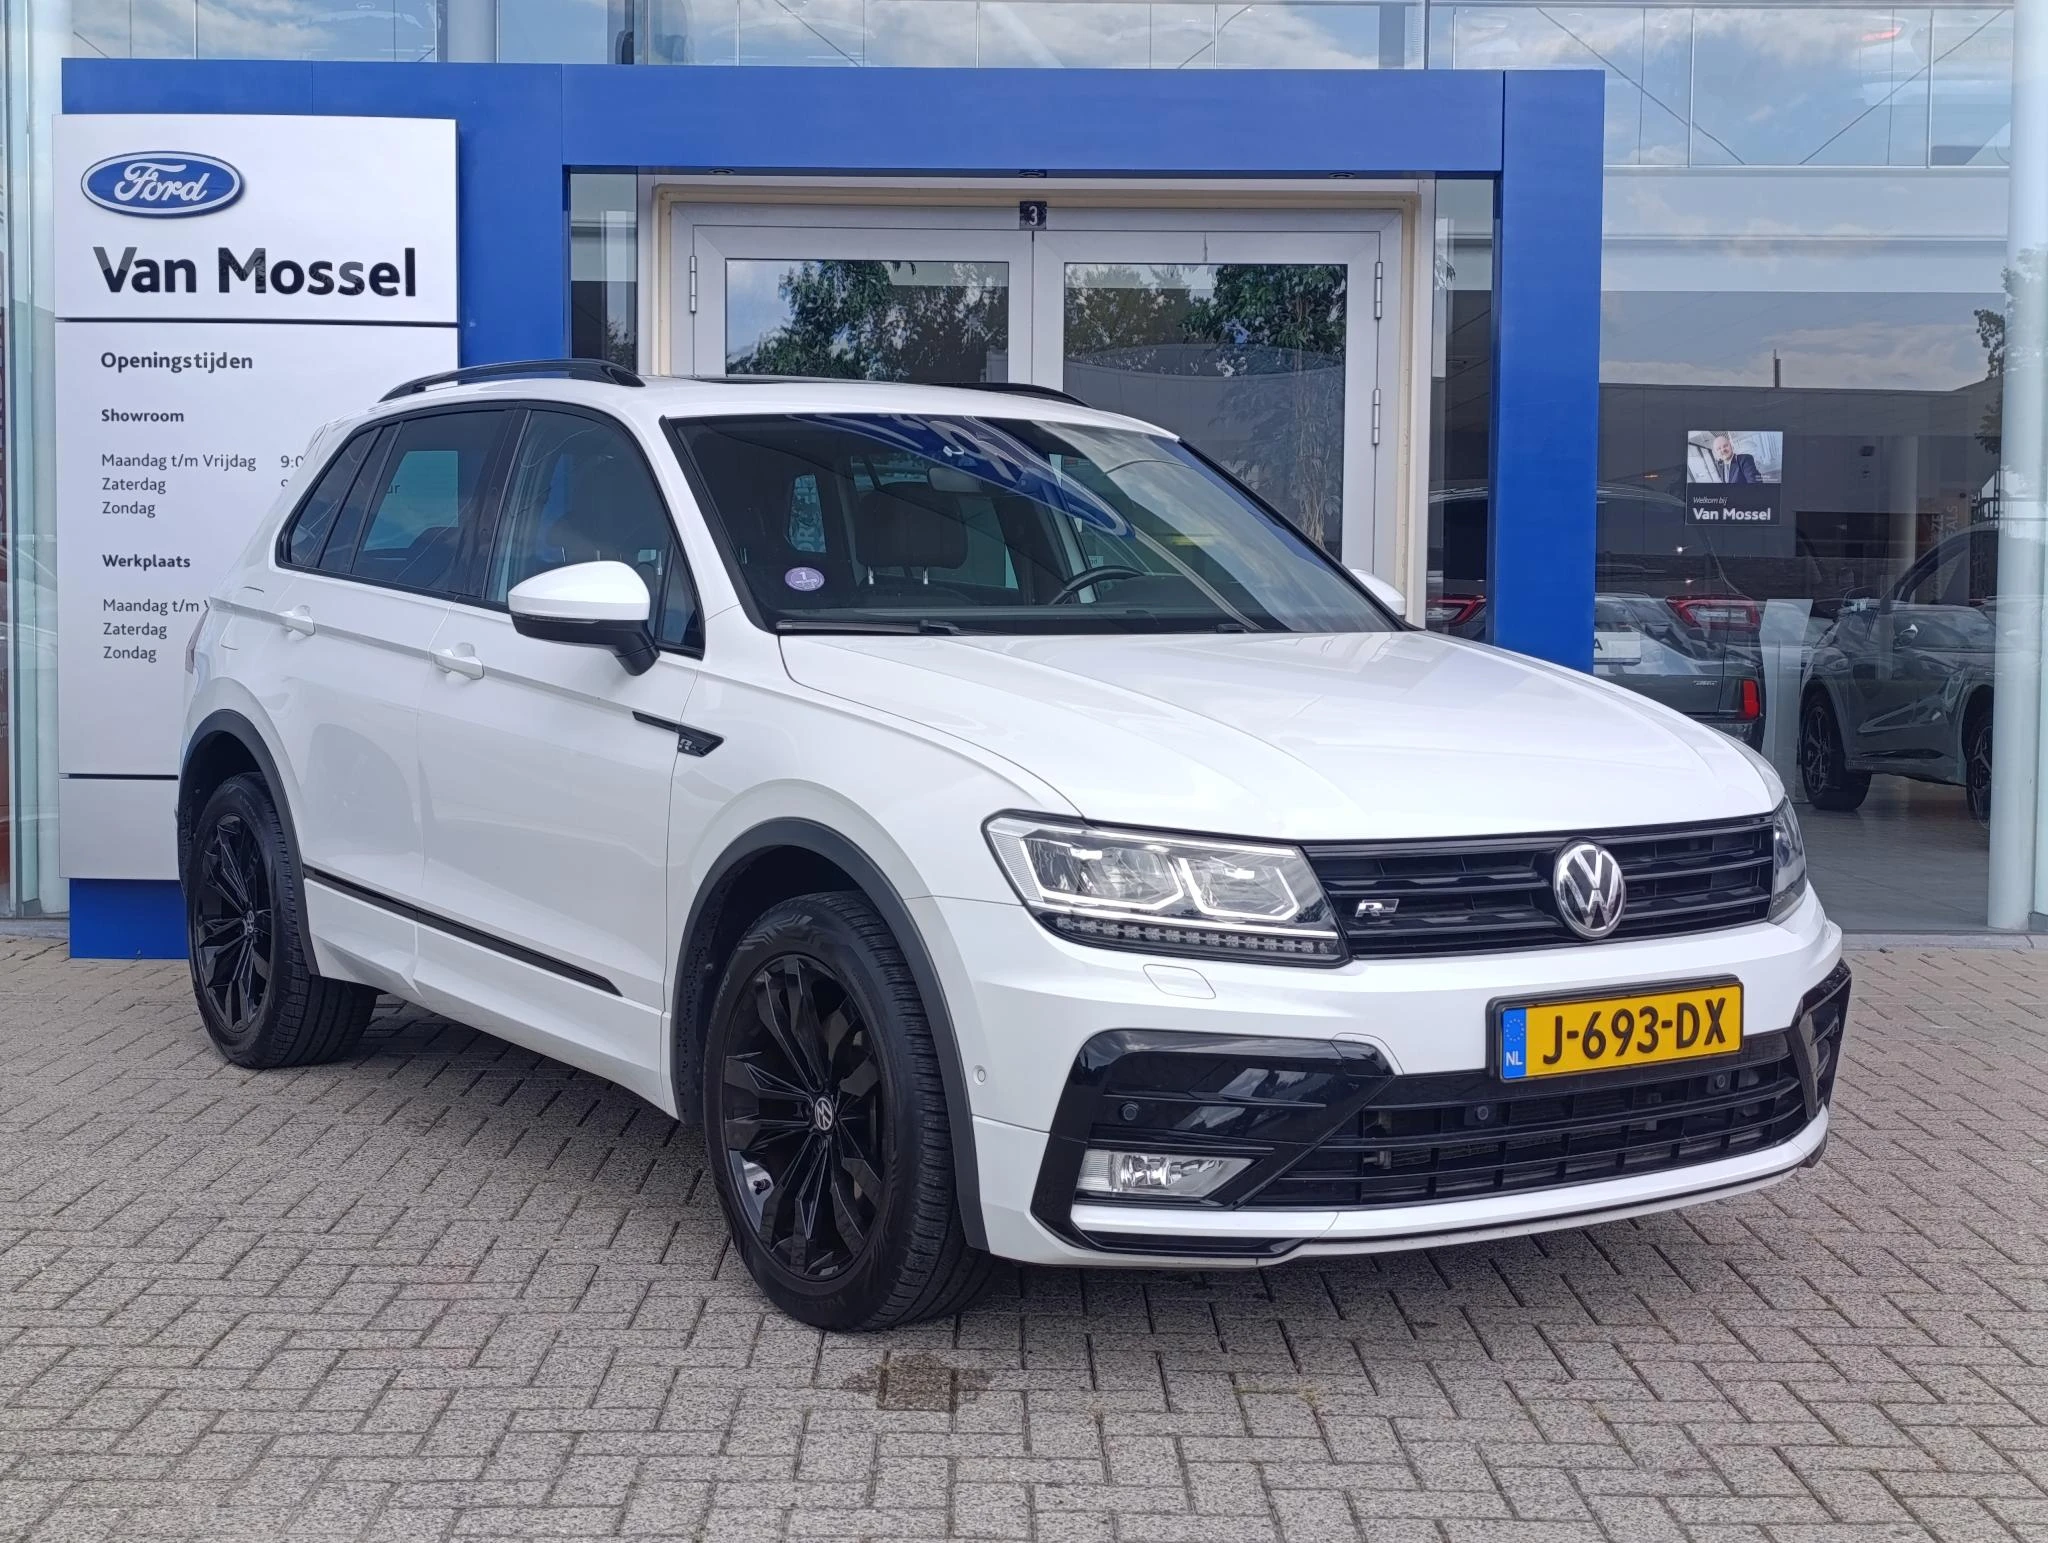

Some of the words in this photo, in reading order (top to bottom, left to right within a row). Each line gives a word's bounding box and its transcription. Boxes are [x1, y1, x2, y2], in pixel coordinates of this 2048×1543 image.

[113, 162, 211, 201] Ford
[1029, 205, 1038, 226] 3
[93, 246, 197, 294] Van
[217, 247, 416, 297] Mossel
[100, 351, 253, 374] Openingstijden
[101, 408, 185, 423] Showroom
[101, 453, 168, 471] Maandag
[170, 453, 199, 468] t/m
[203, 454, 257, 472] Vrijdag
[101, 476, 167, 495] Zaterdag
[101, 500, 156, 519] Zondag
[1693, 496, 1718, 504] Welkom
[1719, 496, 1728, 506] bij
[1692, 507, 1719, 520] Van
[1722, 507, 1771, 521] Mossel
[101, 553, 191, 572] Werkplaats
[103, 598, 169, 617] Maandag
[171, 598, 200, 613] t/m
[103, 622, 168, 640] Zaterdag
[103, 645, 157, 664] Zondag
[1542, 997, 1727, 1066] J-693-DX
[1505, 1051, 1523, 1066] NL
